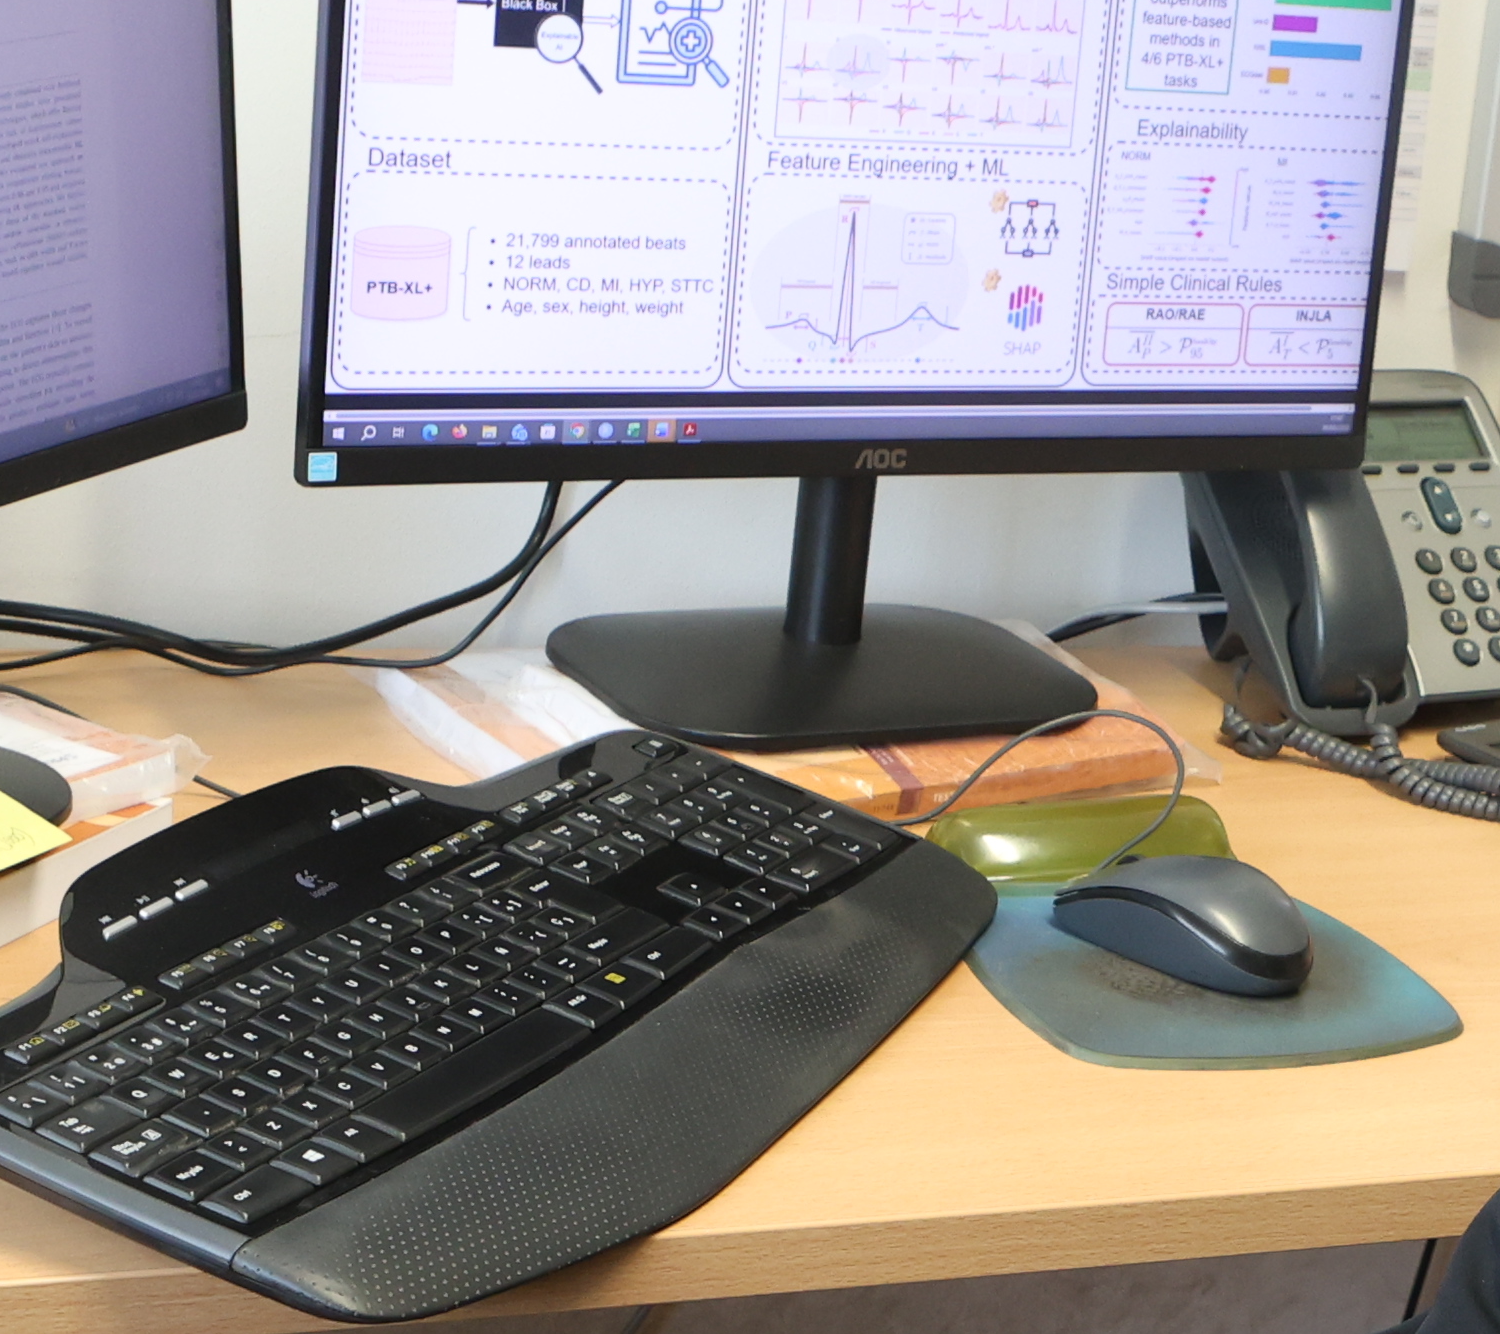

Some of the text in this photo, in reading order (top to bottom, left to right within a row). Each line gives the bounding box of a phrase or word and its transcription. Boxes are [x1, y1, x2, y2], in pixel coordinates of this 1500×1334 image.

[536, 0, 558, 12] Box
[1142, 10, 1232, 30] feature-based
[1149, 32, 1221, 49] methods in
[1141, 51, 1224, 69] 4/6 PTB-XL+
[1164, 72, 1198, 88] tasks
[1137, 118, 1248, 144] Explainability
[368, 147, 452, 169] Dataset
[767, 150, 1010, 180] Feature Engineering + ML
[1121, 150, 1151, 162] NORM
[506, 233, 686, 251] 21,799 annotated beats
[506, 255, 571, 270] 12 leads
[366, 280, 434, 295] PTB-XL+
[504, 277, 714, 295] NORM, CD, MI, HYP, STTC
[1107, 273, 1282, 294] Simple Clinical Rules
[501, 299, 684, 317] Age, sex, height, weight
[1146, 307, 1206, 321] RAO/RAE
[1003, 341, 1041, 355] SHAP
[855, 448, 908, 469] AOC
